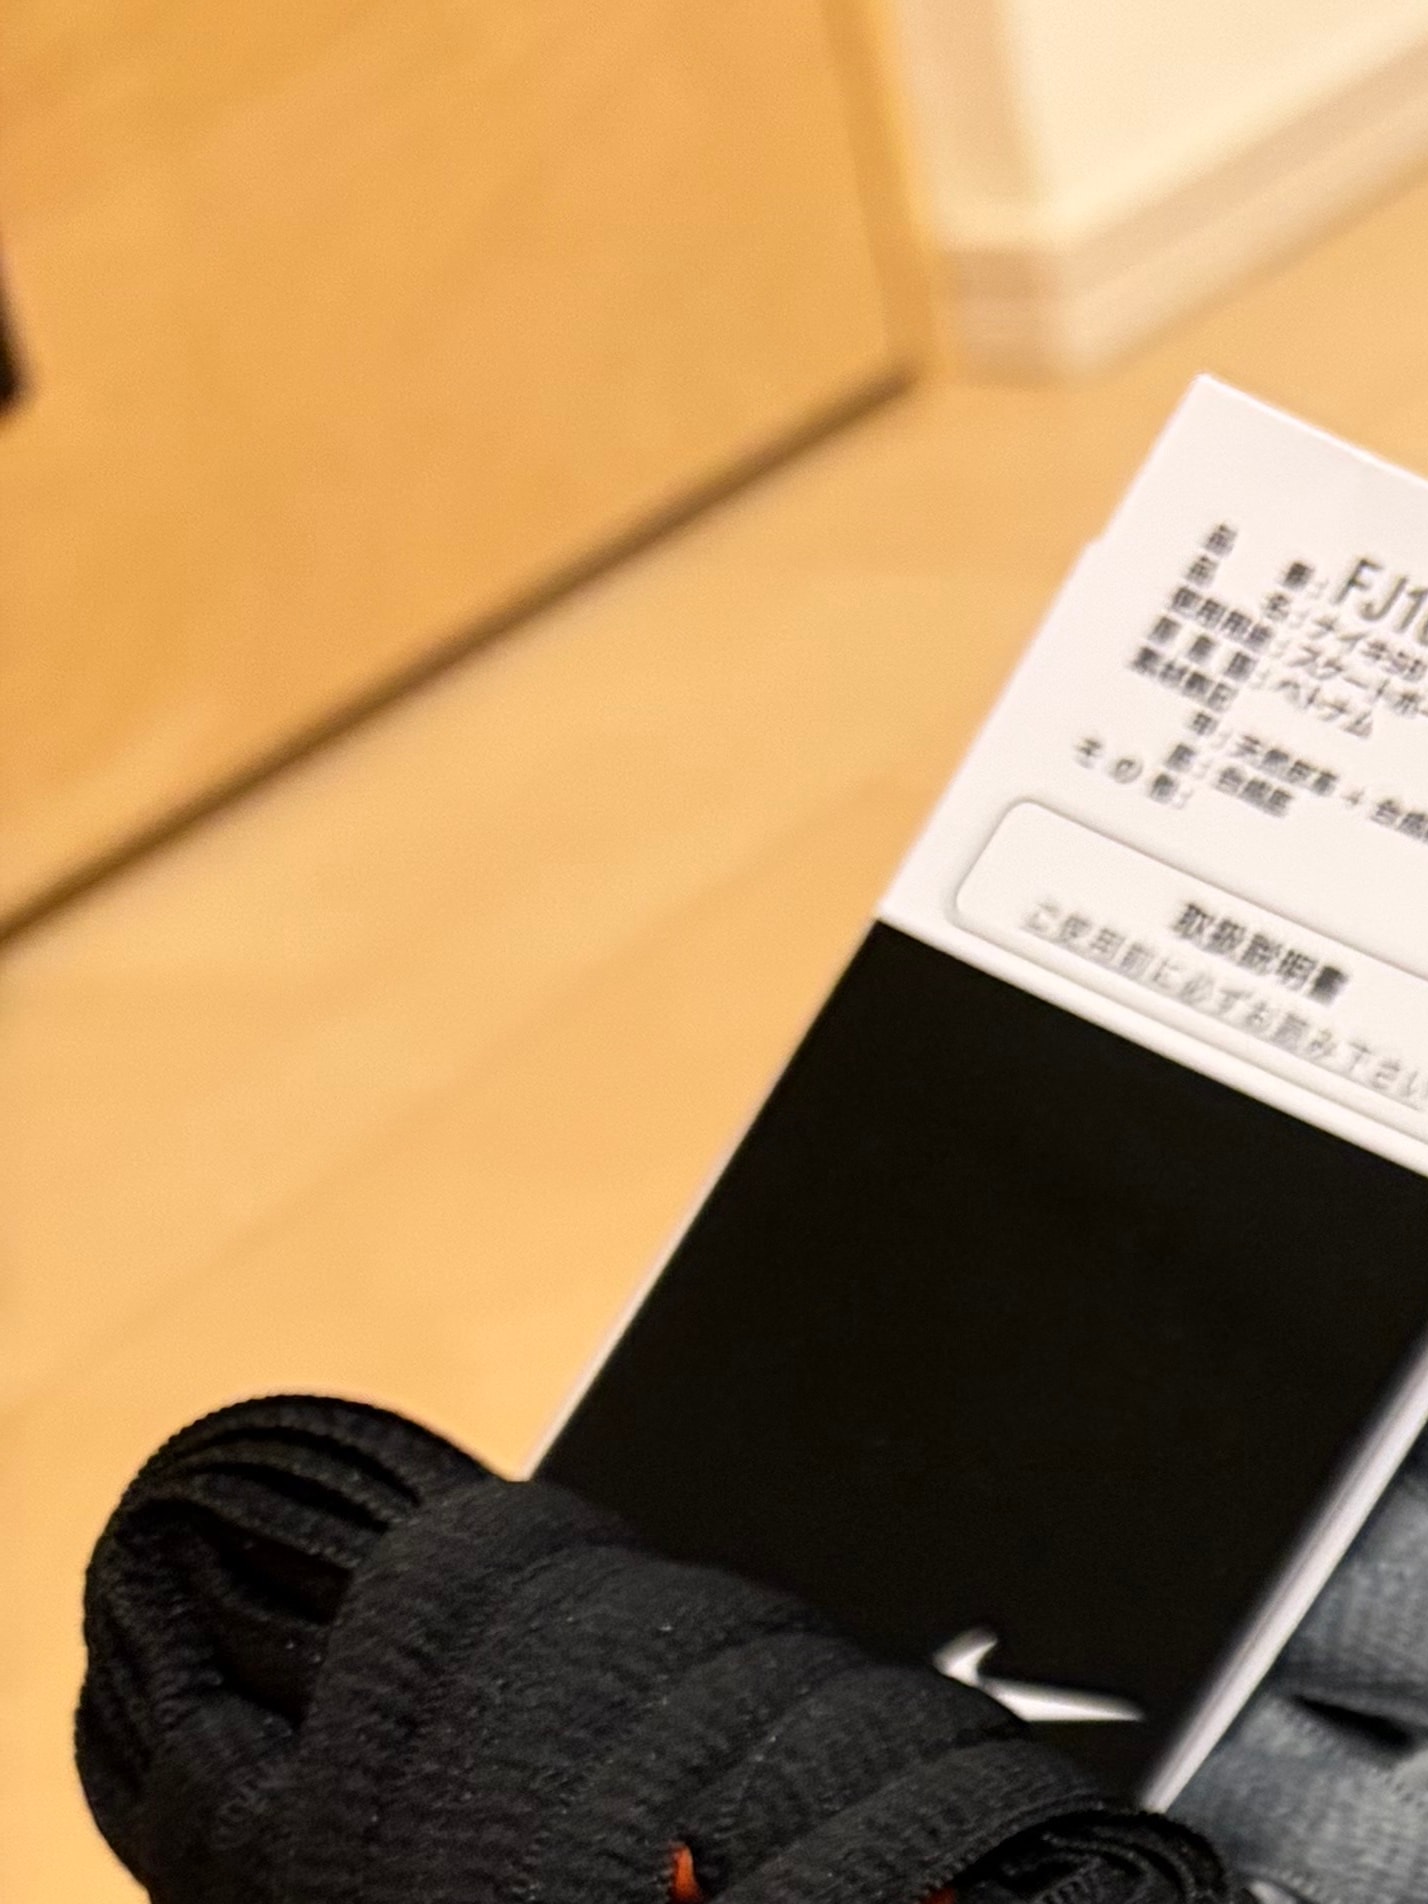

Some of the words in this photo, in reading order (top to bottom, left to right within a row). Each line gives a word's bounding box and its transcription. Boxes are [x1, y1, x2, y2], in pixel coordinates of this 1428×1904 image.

[1163, 898, 1353, 1010] 取扱説明書
